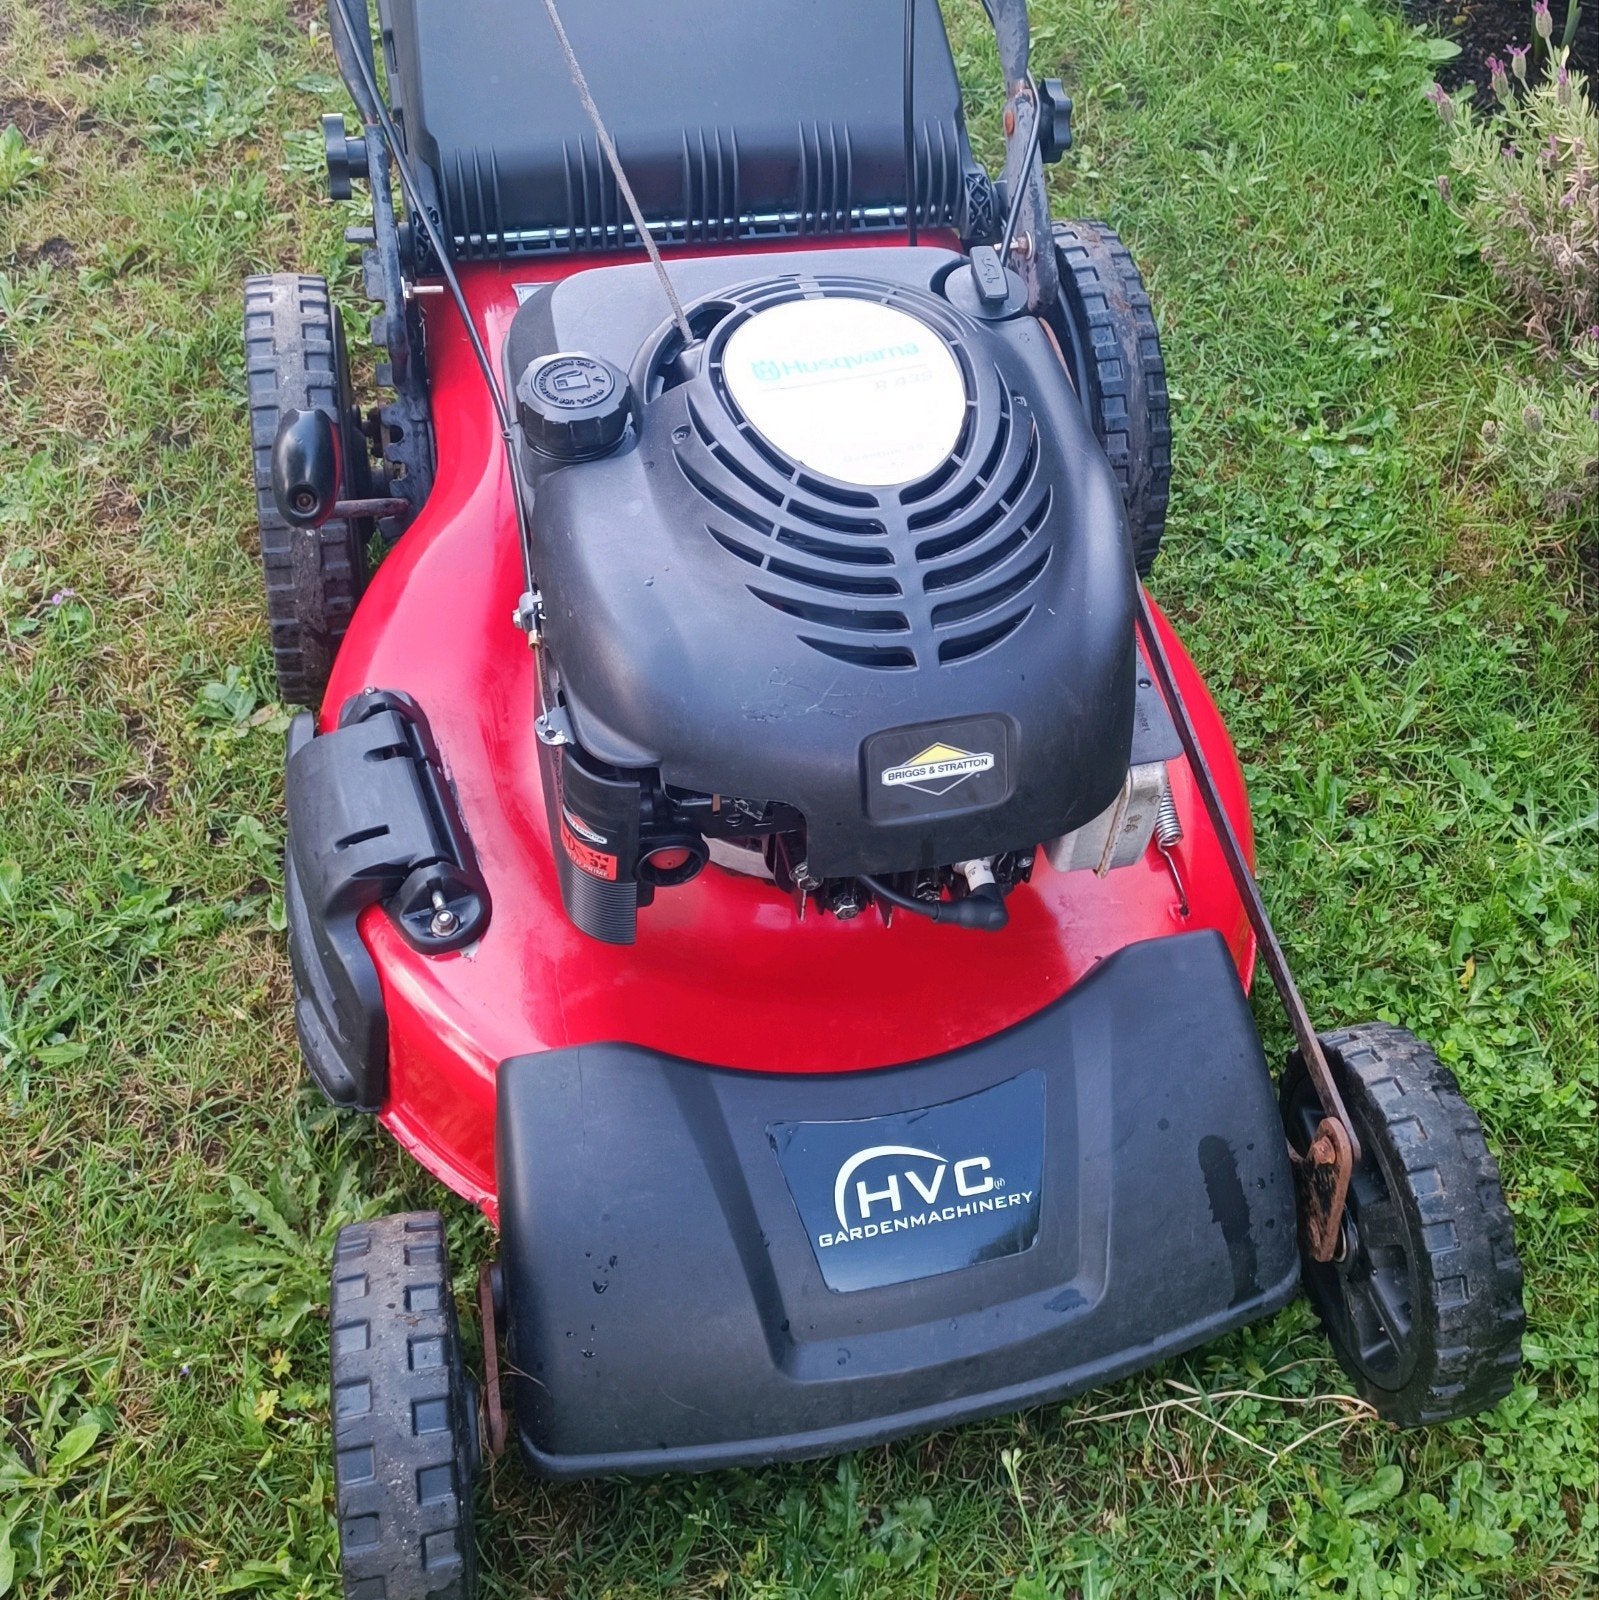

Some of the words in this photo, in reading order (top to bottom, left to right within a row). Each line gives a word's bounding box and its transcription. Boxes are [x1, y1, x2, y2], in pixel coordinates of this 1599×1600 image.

[781, 342, 920, 378] Husqvarna
[888, 767, 926, 781] BRIGGS
[928, 766, 936, 774] &
[937, 758, 988, 773] STRATTON
[856, 1156, 994, 1219] HVC
[818, 1190, 1033, 1248] GARDENMACHINERY
